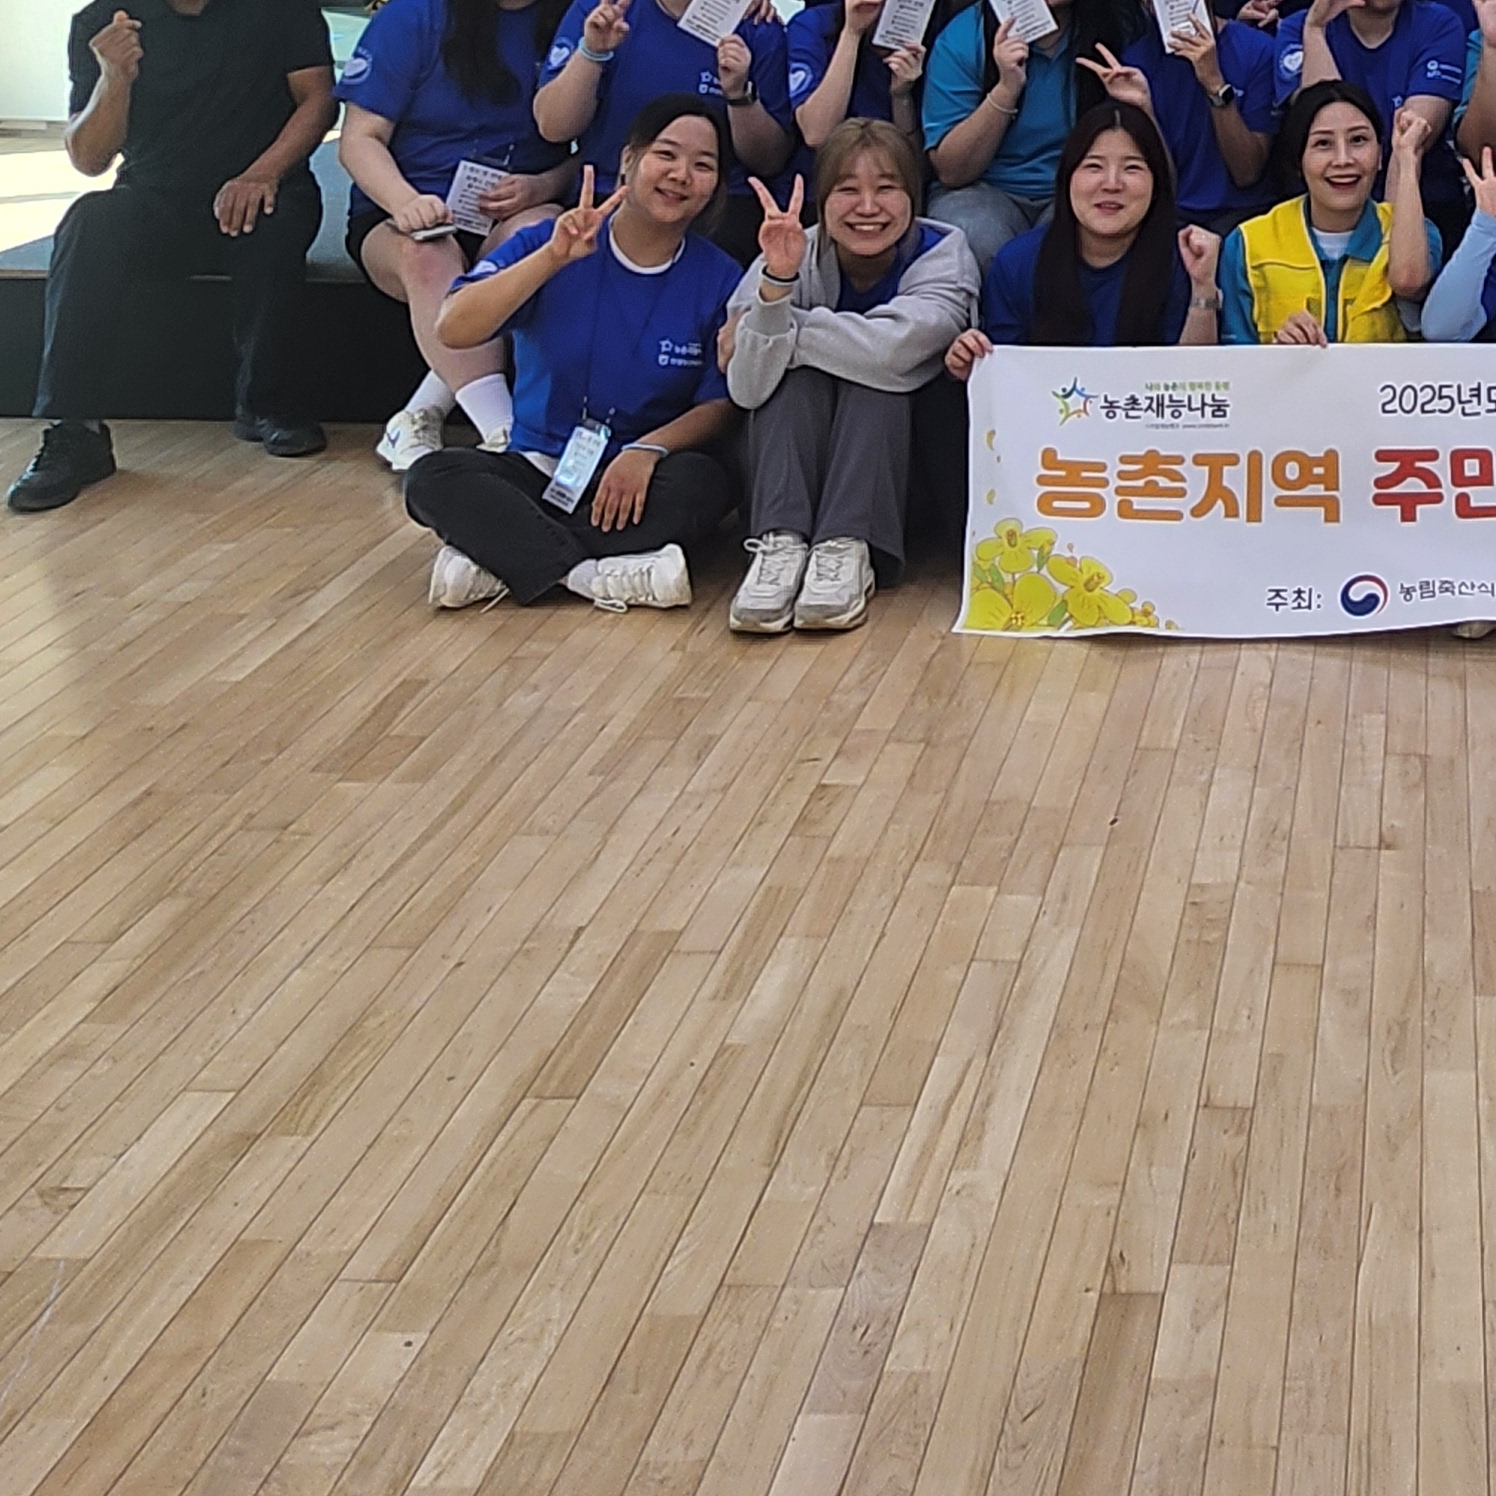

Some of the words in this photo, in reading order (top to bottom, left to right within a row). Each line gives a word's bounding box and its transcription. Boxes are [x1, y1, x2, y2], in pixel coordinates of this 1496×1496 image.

[1100, 394, 1230, 420] 농촌재능나눔
[1035, 446, 1340, 524] 농촌지역
[1266, 585, 1323, 613] 주최:
